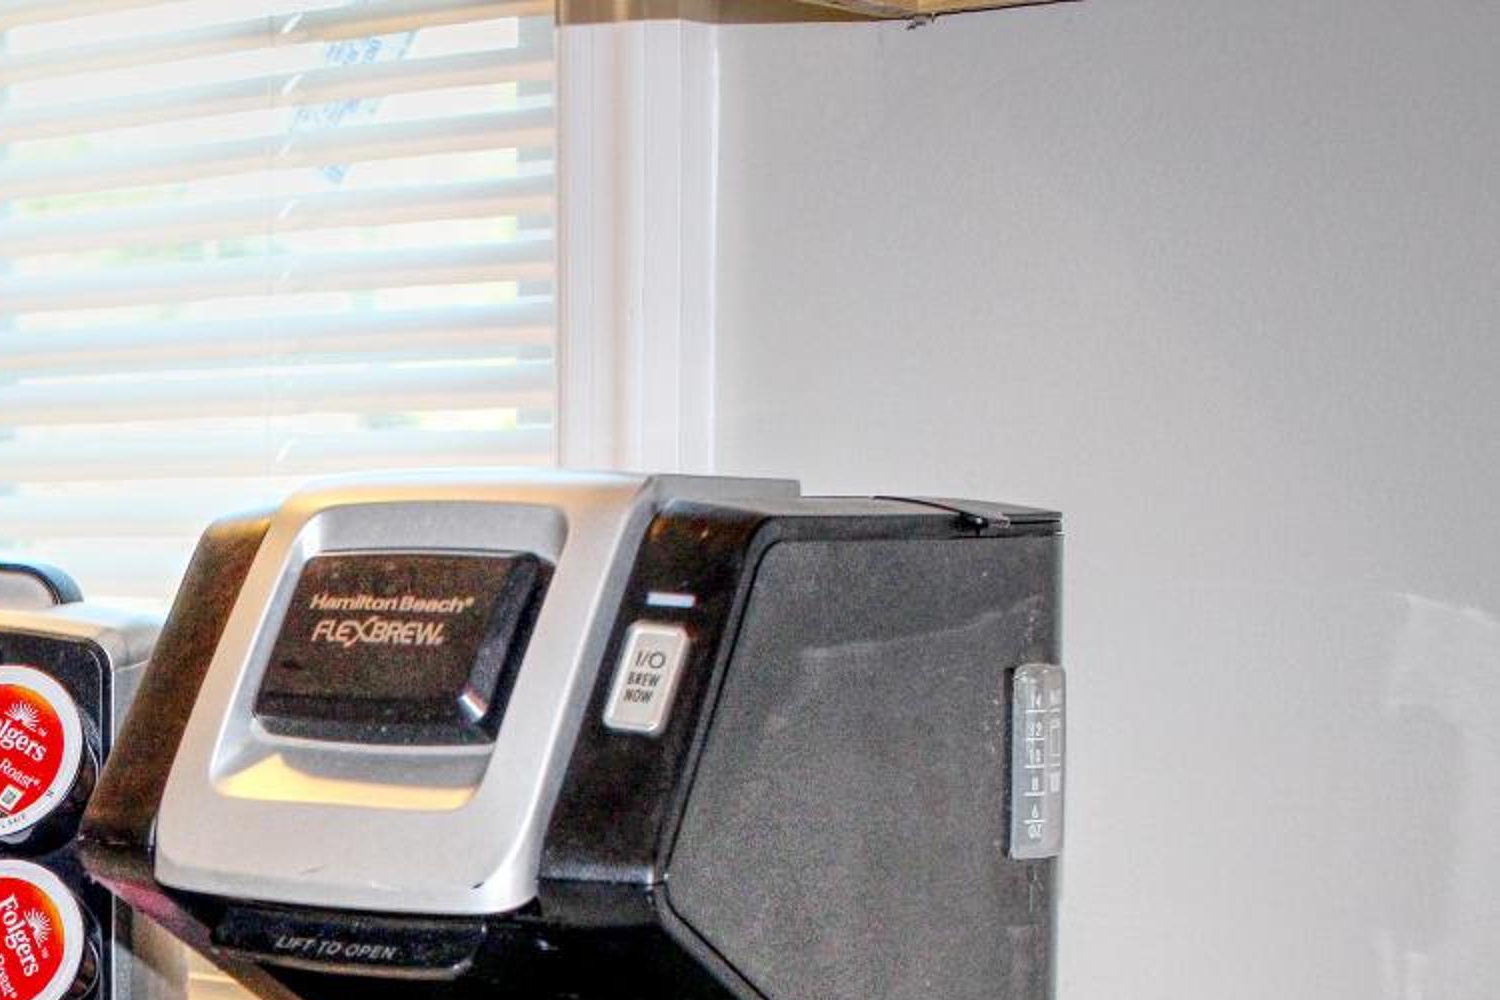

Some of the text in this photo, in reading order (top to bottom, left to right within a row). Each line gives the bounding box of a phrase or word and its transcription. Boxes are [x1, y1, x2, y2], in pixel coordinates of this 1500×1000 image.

[309, 593, 398, 611] Hamilton
[627, 671, 660, 687] BREW
[624, 689, 654, 704] NOW
[275, 935, 399, 959] LIFT TO OPEN
